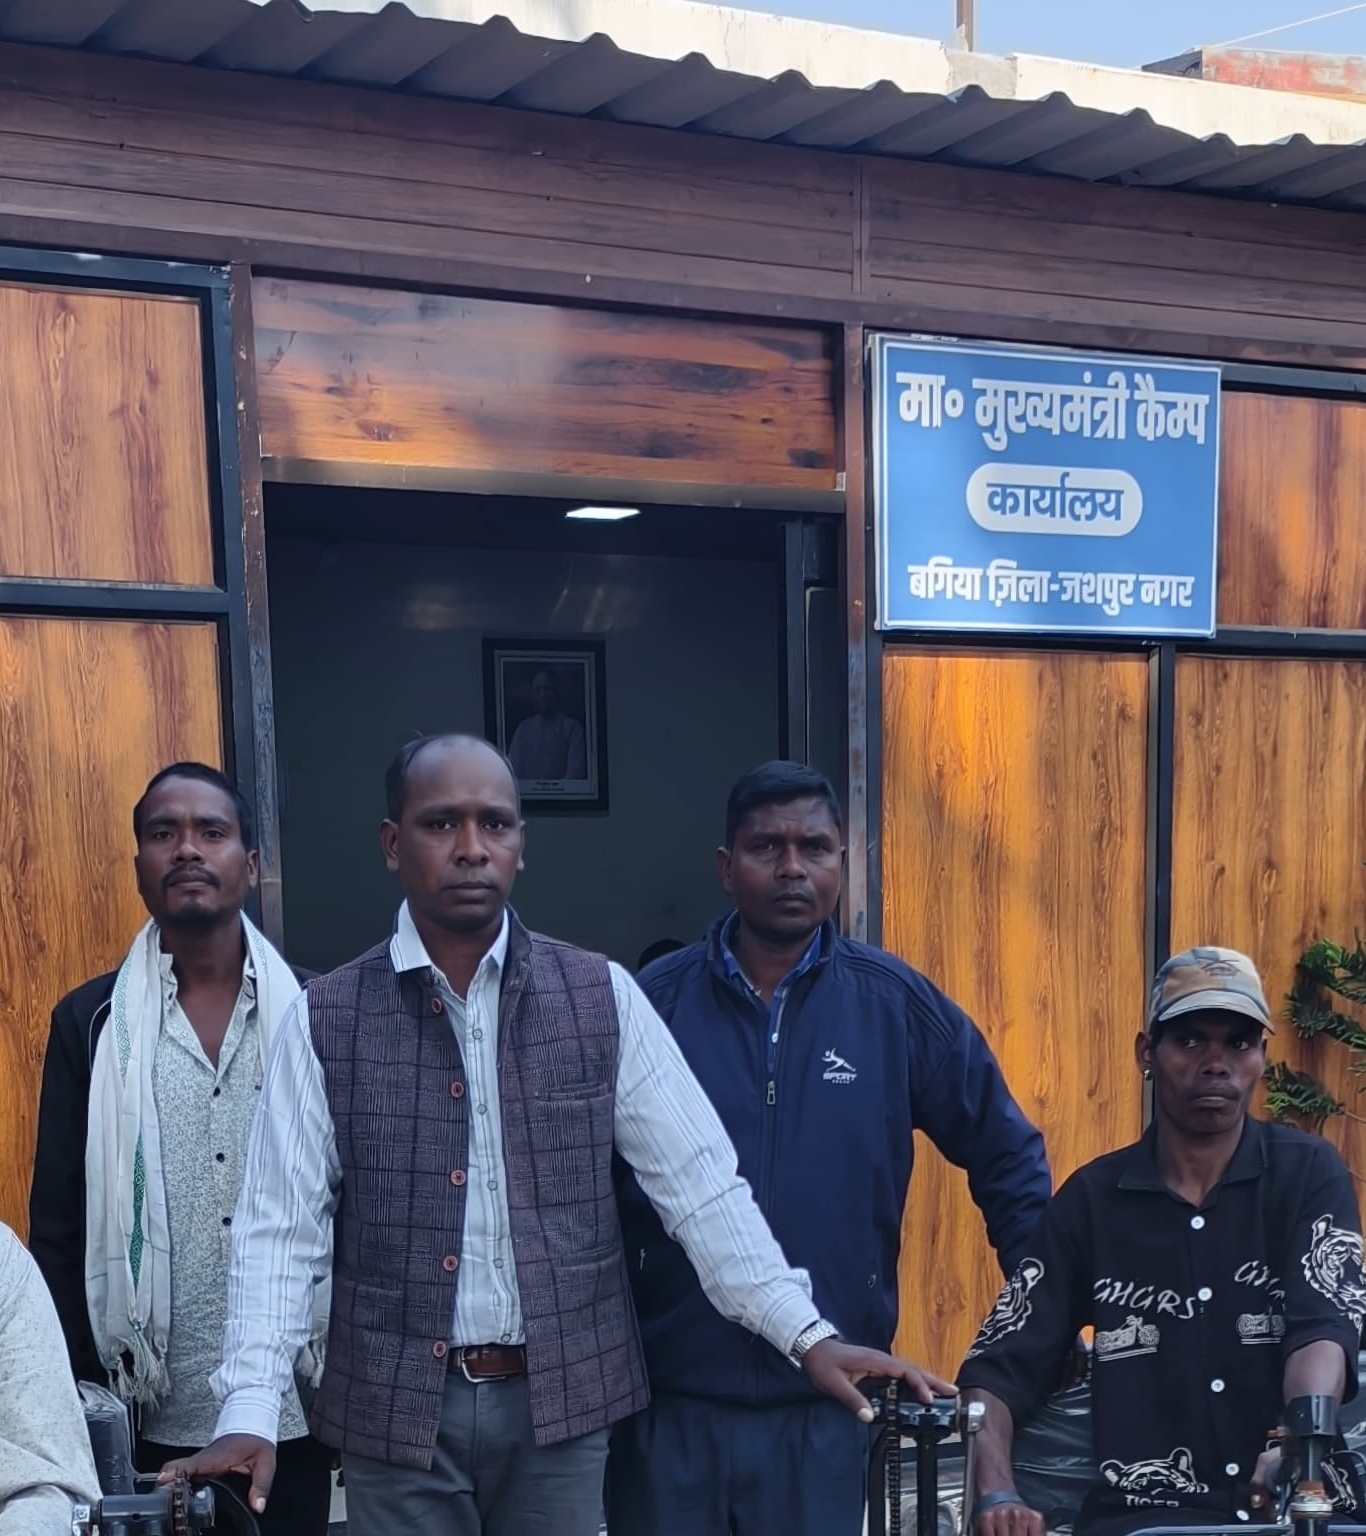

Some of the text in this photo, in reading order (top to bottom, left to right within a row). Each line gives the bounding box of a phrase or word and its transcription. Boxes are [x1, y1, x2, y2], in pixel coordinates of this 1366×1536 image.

[972, 371, 1130, 451] मुख्यमंत्री
[1134, 373, 1210, 445] कैम्प
[986, 472, 1125, 521] कार्यालय
[907, 556, 984, 601] बगिया
[1139, 574, 1195, 608] नगर
